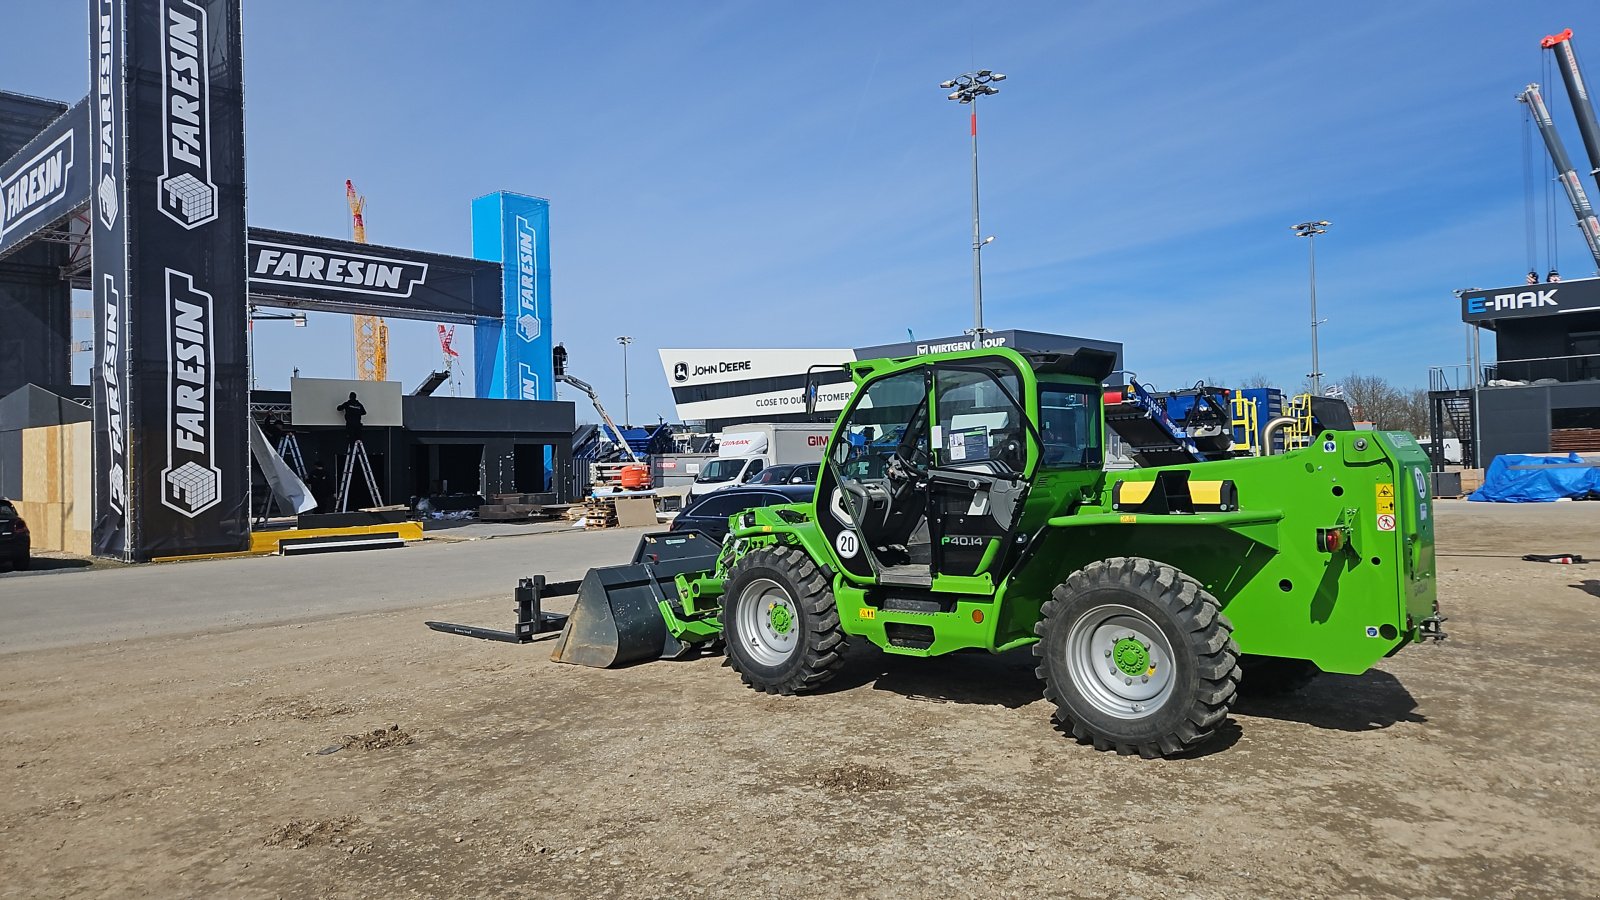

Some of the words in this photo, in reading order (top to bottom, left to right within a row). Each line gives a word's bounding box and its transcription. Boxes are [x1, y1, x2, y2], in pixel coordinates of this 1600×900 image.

[101, 15, 112, 164] FARESIN
[169, 7, 201, 168] FARESIN
[6, 149, 63, 222] FARESIN
[255, 249, 403, 290] FARESIN
[519, 231, 534, 311] FARESIN
[1468, 288, 1559, 314] E-MAK
[929, 341, 970, 354] WIRTGEN
[104, 303, 124, 456] FARESIN
[173, 298, 206, 456] FARESIN
[692, 362, 717, 377] JOHN
[719, 360, 752, 372] DEERE
[755, 398, 778, 407] CLOSE
[779, 397, 789, 405] TO
[721, 439, 751, 447] GIMAX
[807, 435, 829, 447] GIM
[839, 536, 855, 552] 20
[941, 536, 983, 546] P40.14
